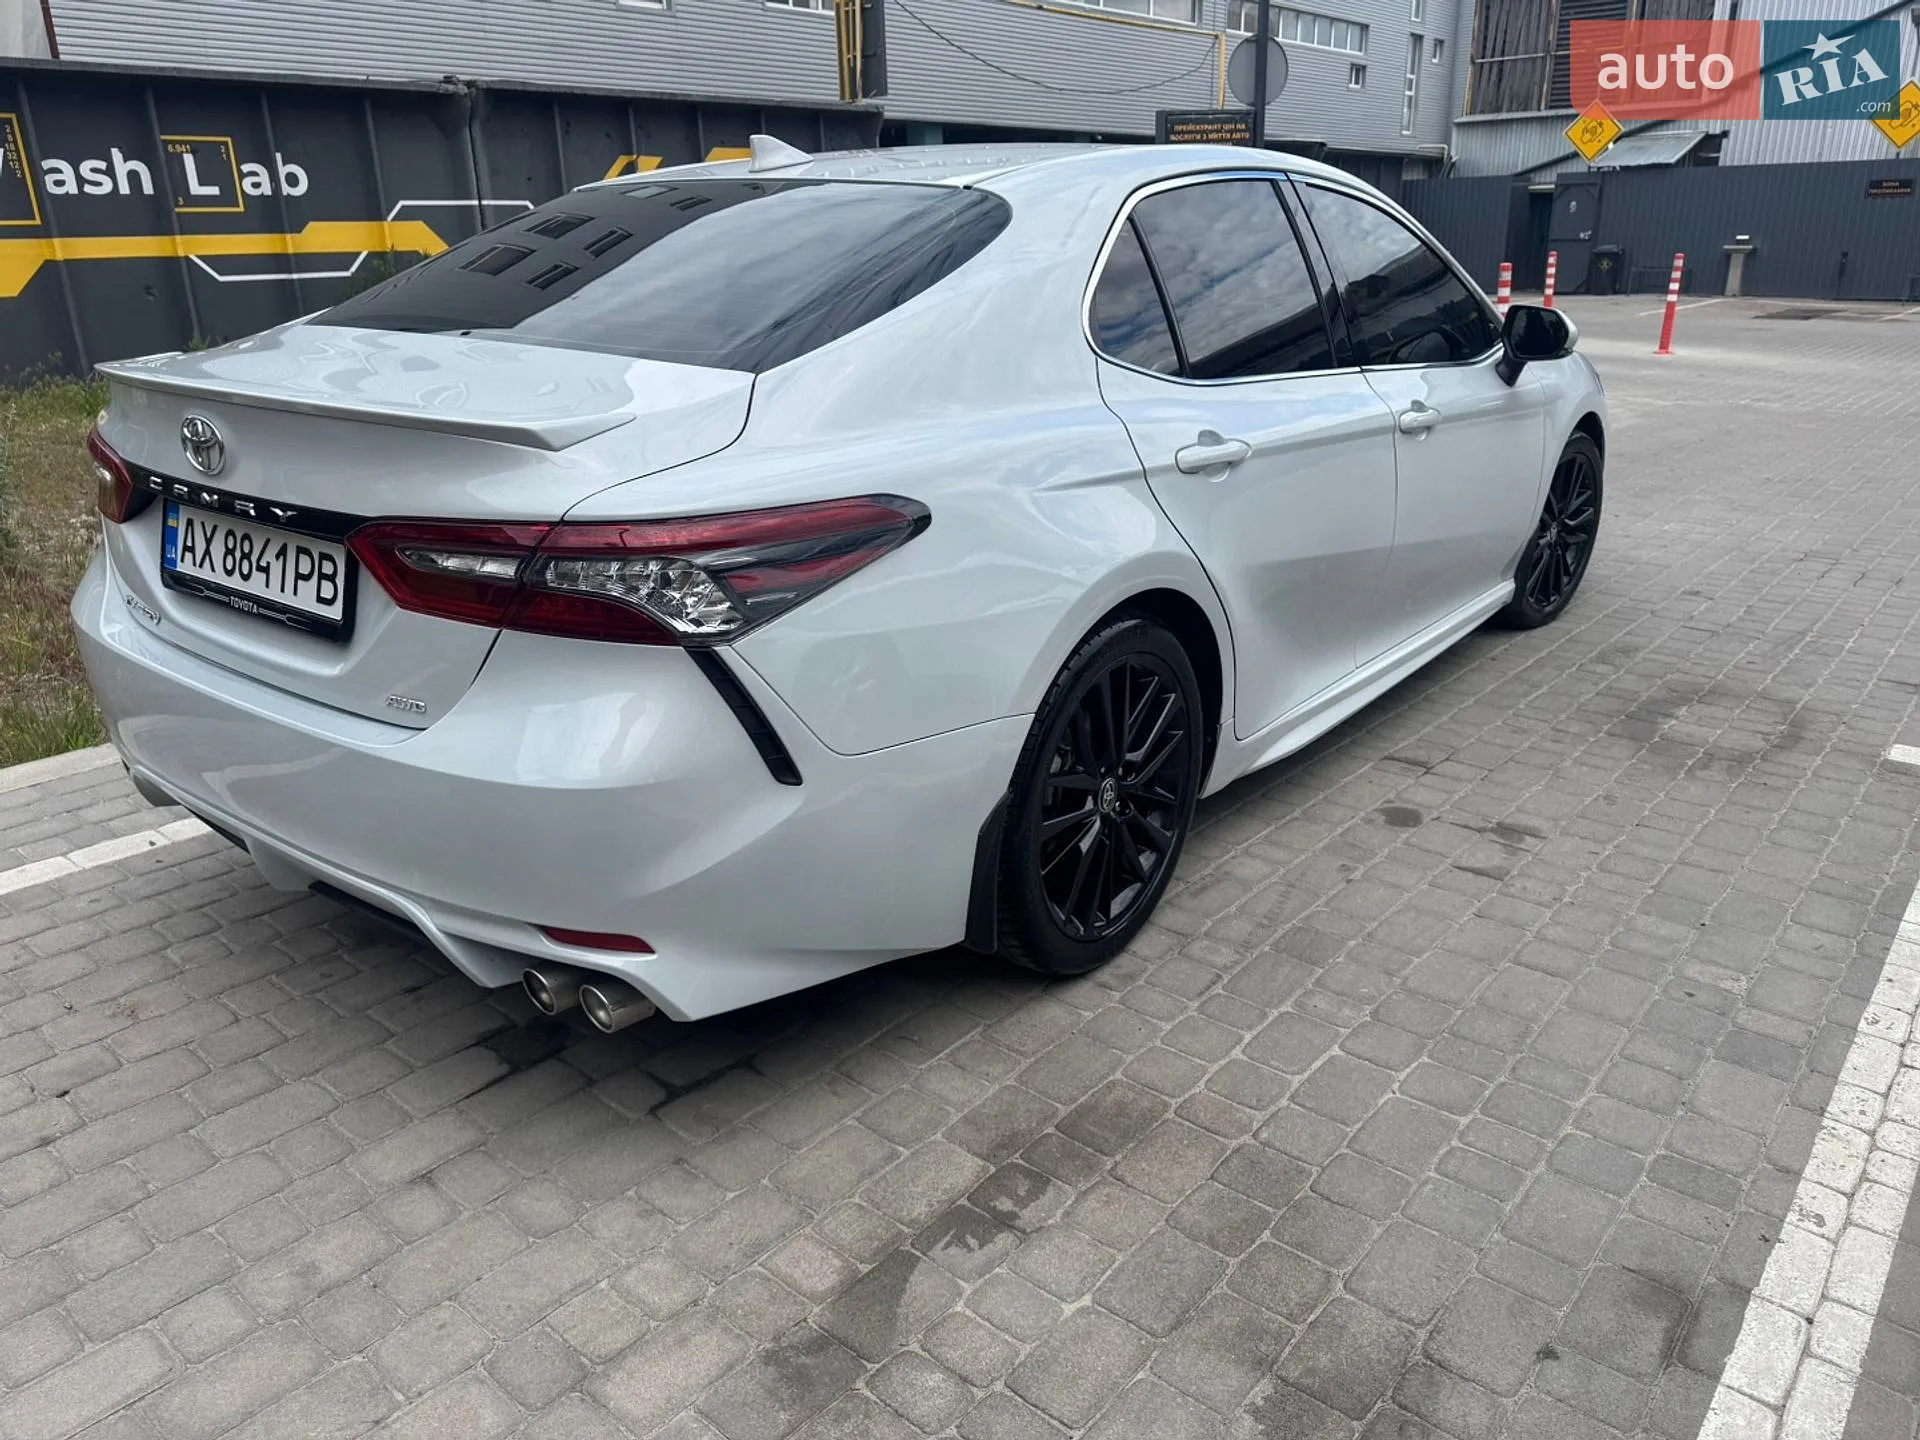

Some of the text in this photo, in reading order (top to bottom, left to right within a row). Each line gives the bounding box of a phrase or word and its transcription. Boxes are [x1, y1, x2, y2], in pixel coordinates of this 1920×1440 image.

[0, 147, 309, 197] ash Lab
[230, 596, 258, 615] TOYOTA
